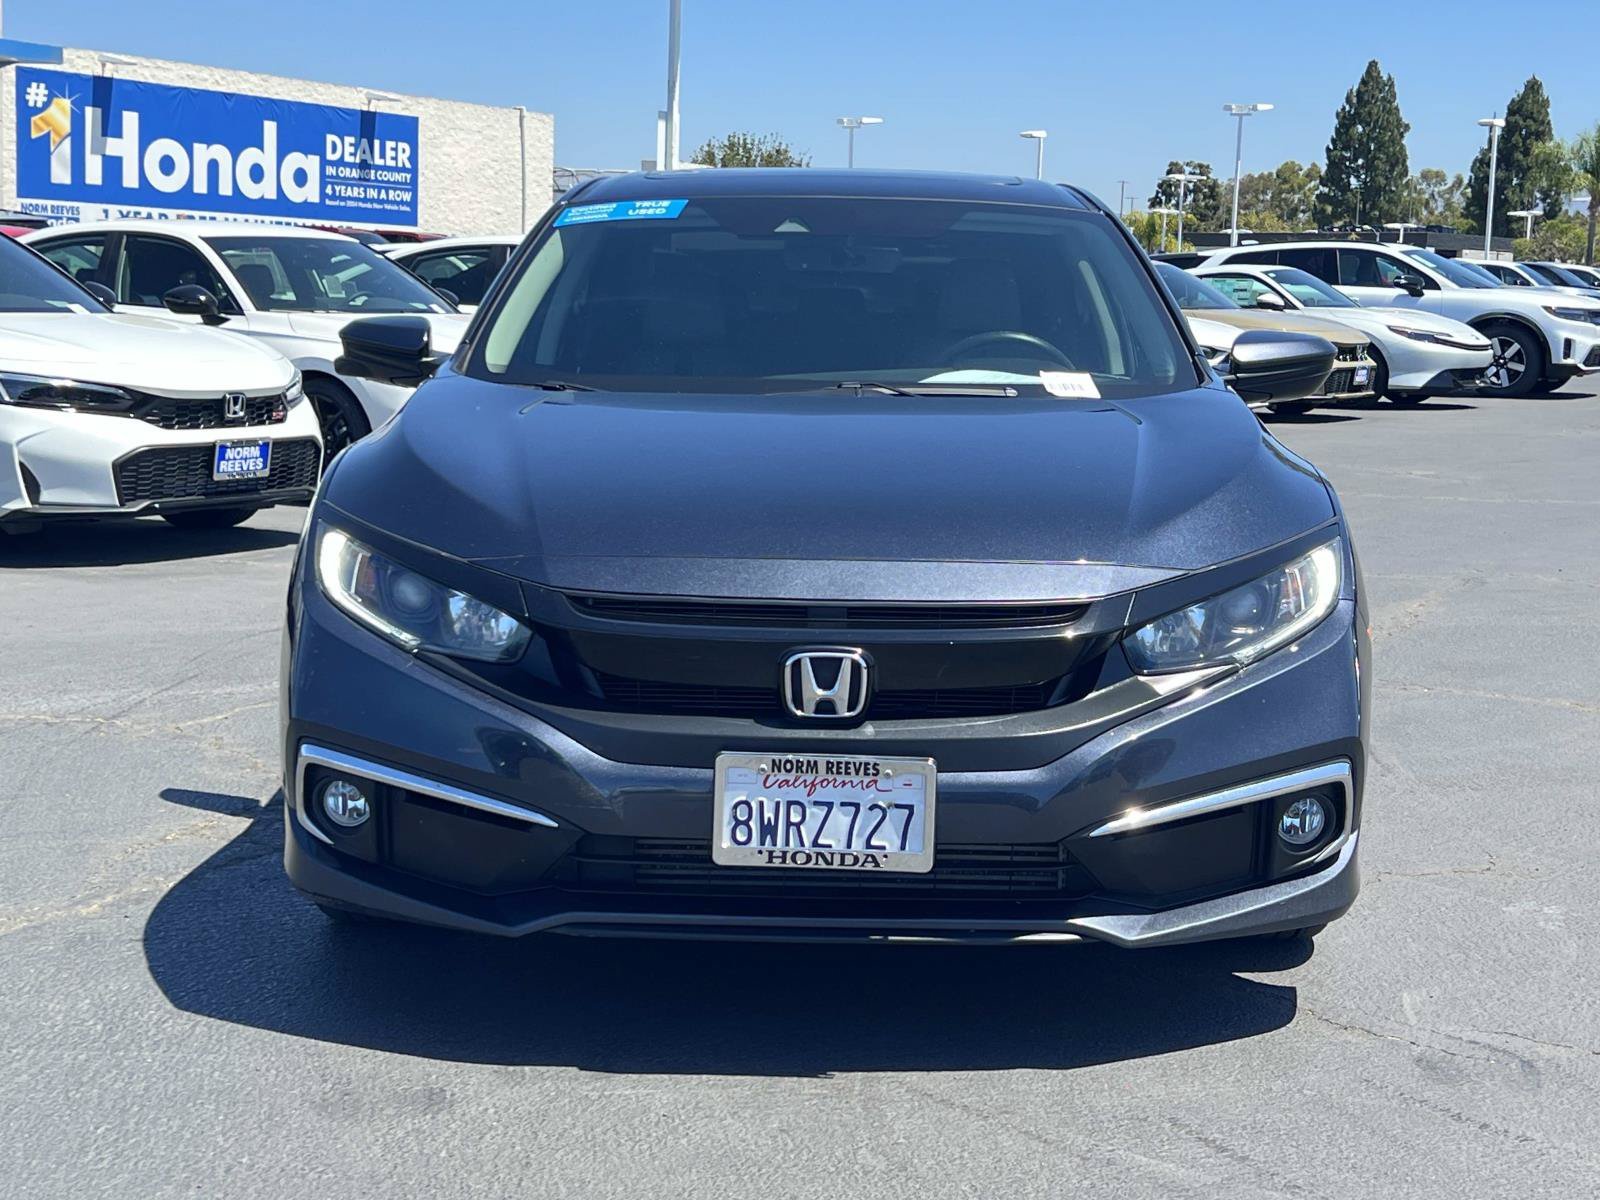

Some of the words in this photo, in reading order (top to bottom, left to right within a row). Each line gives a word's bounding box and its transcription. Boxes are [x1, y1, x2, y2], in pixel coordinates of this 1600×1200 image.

[85, 106, 320, 203] Honda
[326, 133, 412, 168] DEALER
[326, 166, 336, 176] IN
[338, 167, 375, 180] ORANGE
[377, 171, 412, 183] COUNTY
[325, 184, 332, 196] 4
[334, 185, 365, 199] YEARS
[366, 188, 377, 199] IN
[379, 189, 387, 200] A
[389, 190, 412, 202] ROW
[21, 202, 49, 213] NORM
[50, 205, 80, 216] REEVES
[628, 207, 666, 215] USED
[635, 200, 671, 208] TRUE
[225, 446, 260, 460] NORM
[219, 458, 263, 473] REEVES
[771, 758, 819, 775] NORM
[825, 760, 880, 777] REEVES
[762, 774, 893, 797] California
[731, 799, 915, 851] 8WRZ727
[765, 849, 884, 868] HONDA
